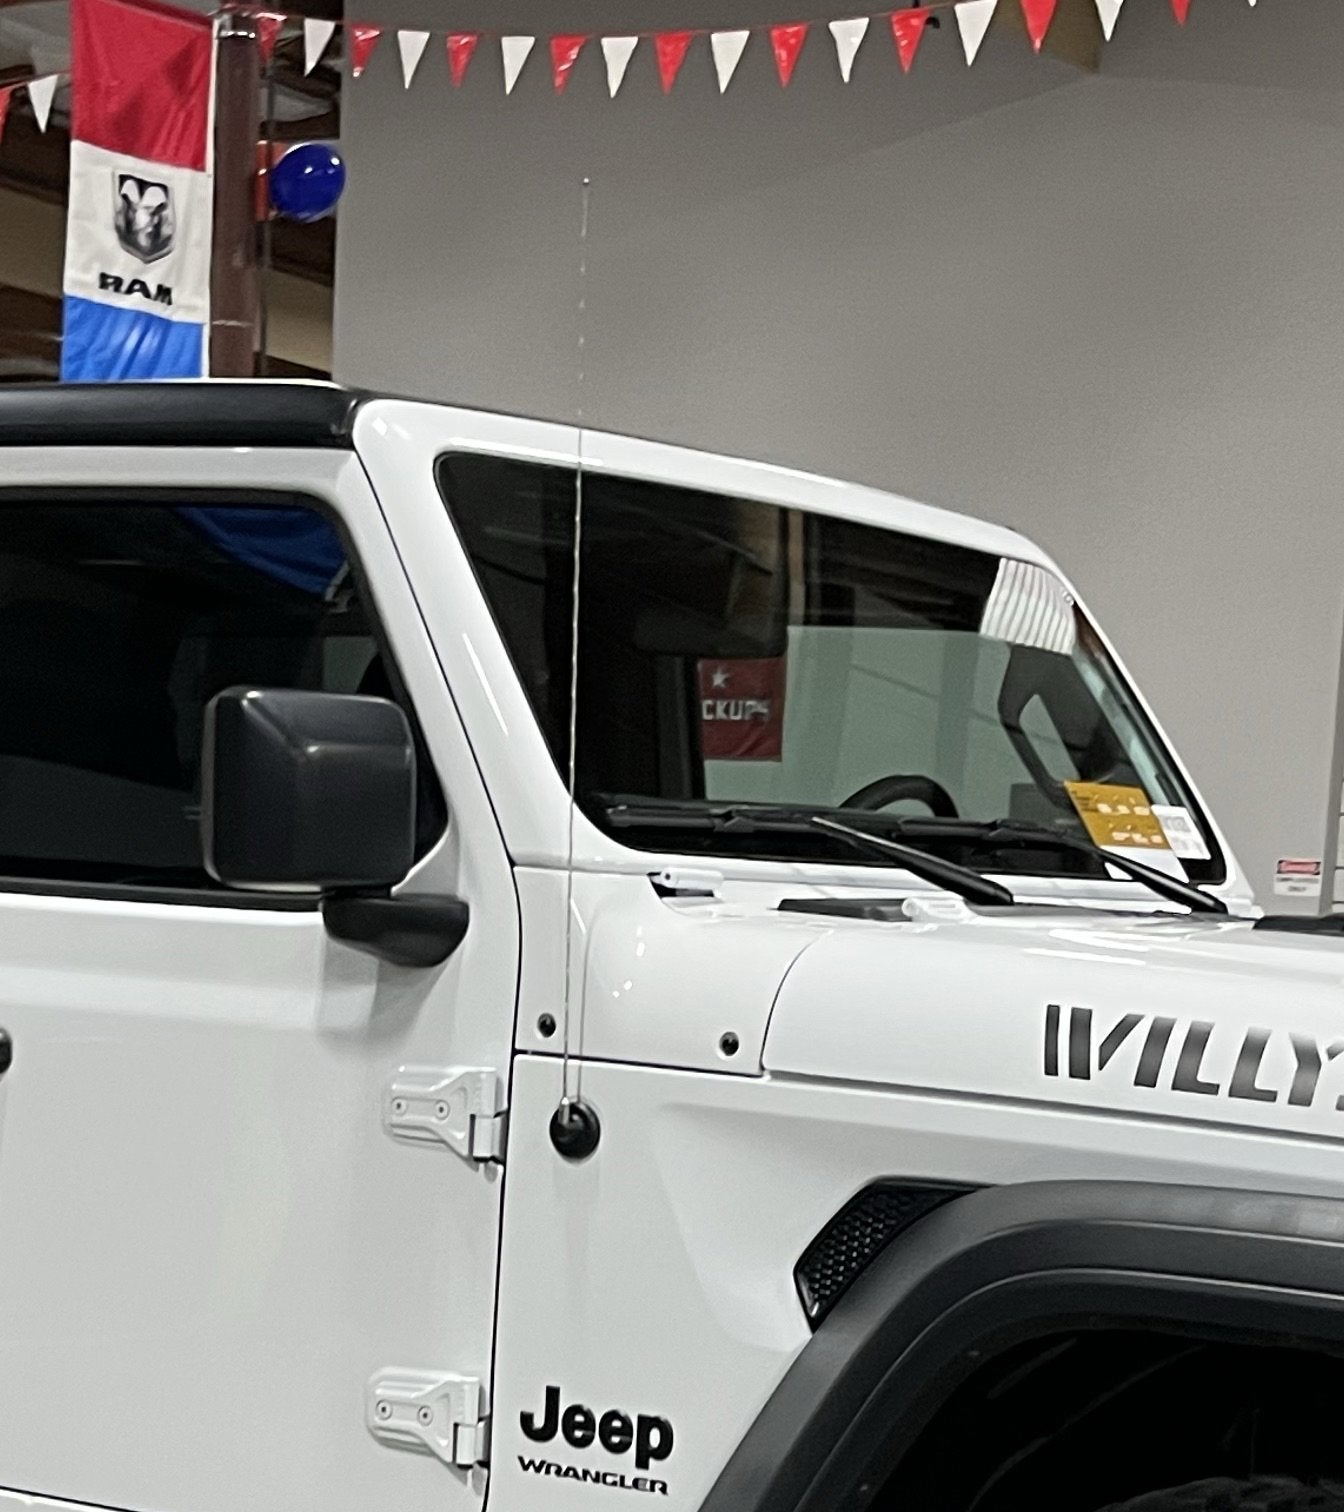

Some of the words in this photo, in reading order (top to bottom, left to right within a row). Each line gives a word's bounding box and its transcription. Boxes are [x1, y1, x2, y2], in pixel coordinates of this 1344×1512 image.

[98, 272, 173, 306] RAM
[520, 1385, 674, 1471] Jeep
[517, 1455, 668, 1496] WRANGLER
